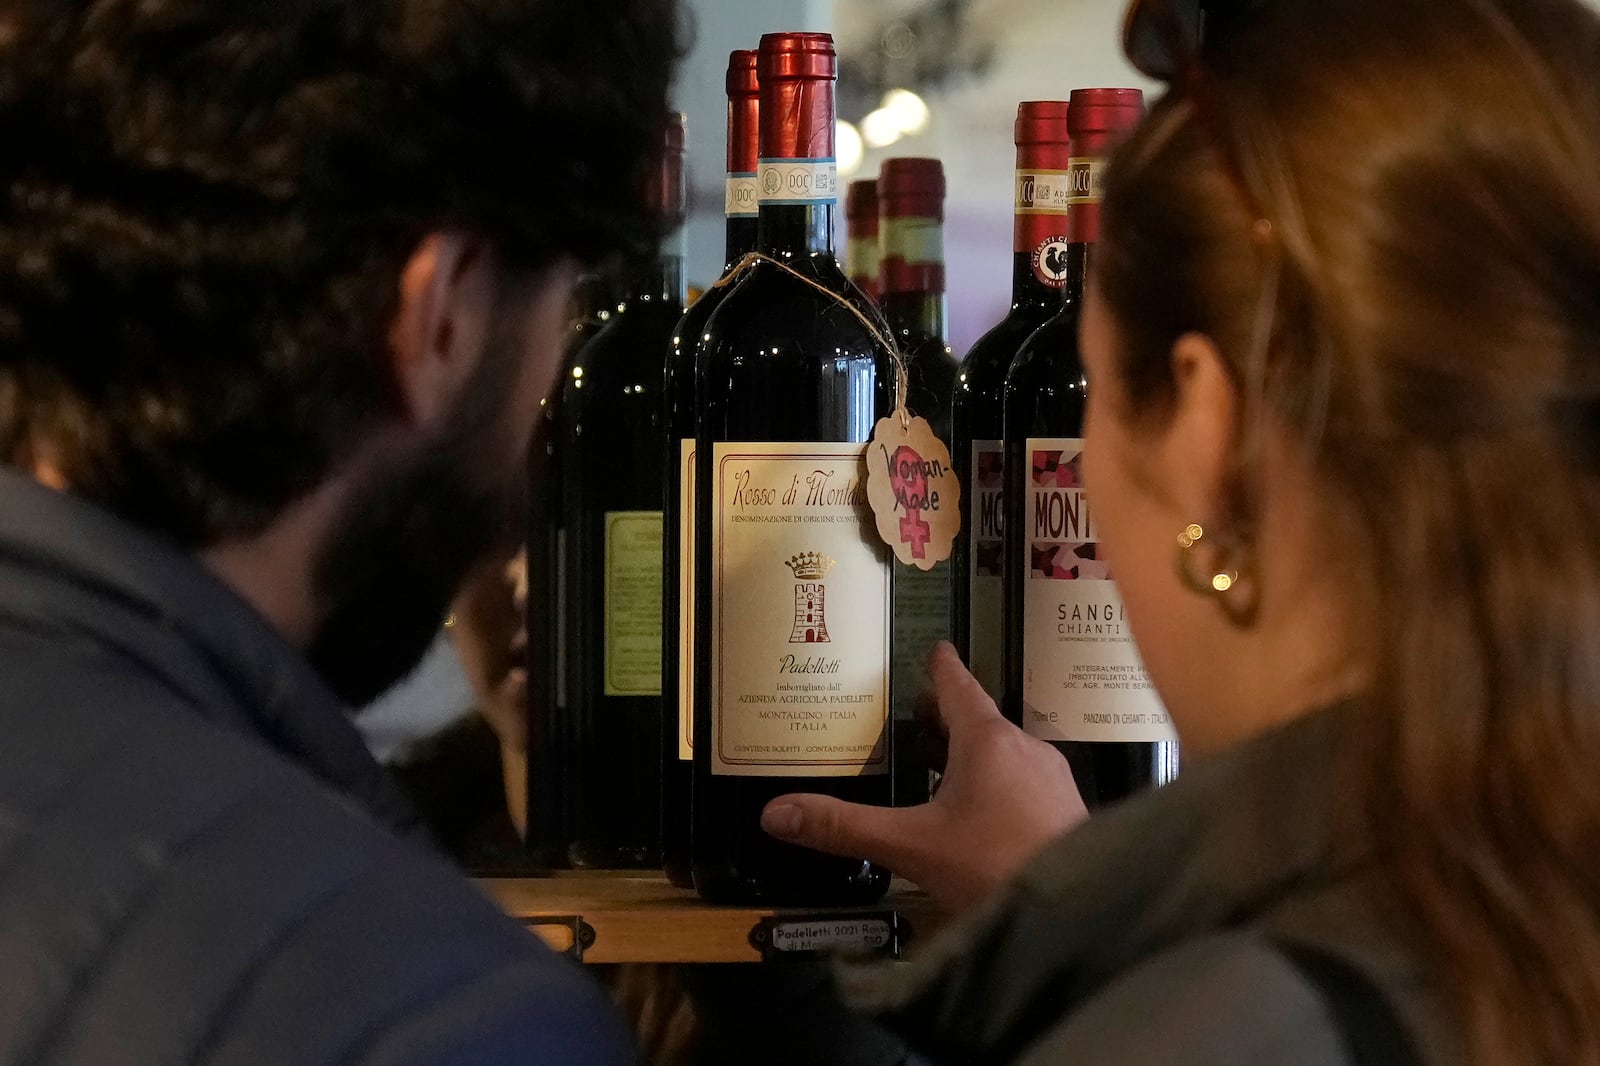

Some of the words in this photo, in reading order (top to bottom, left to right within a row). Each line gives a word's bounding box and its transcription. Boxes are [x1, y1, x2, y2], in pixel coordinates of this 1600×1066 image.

[789, 174, 809, 188] DOC
[737, 188, 754, 202] DOC
[1033, 236, 1055, 267] CHIANTI
[733, 469, 776, 512] Rosso
[782, 473, 799, 506] di
[731, 515, 792, 523] DENOMINAZIONE
[794, 515, 802, 523] DI
[803, 515, 836, 523] ORIGINE
[1057, 623, 1120, 634] CHIANTI
[779, 654, 841, 674] Padelletti
[1068, 673, 1128, 681] IMBOTTIGLIATO
[776, 683, 826, 692] Imbottigliato
[738, 695, 777, 703] AZIENDA
[779, 695, 828, 703] AGRICOLA
[830, 694, 874, 703] PADELLETTI
[759, 711, 823, 720] MONTALCINO
[829, 711, 857, 720] ITALIA
[1083, 713, 1112, 724] PANZANO
[1113, 713, 1120, 724] IN
[1121, 713, 1146, 724] CHIANTI
[790, 722, 828, 731] ITALIA
[777, 927, 832, 940] Padelletti
[834, 925, 858, 936] 2021
